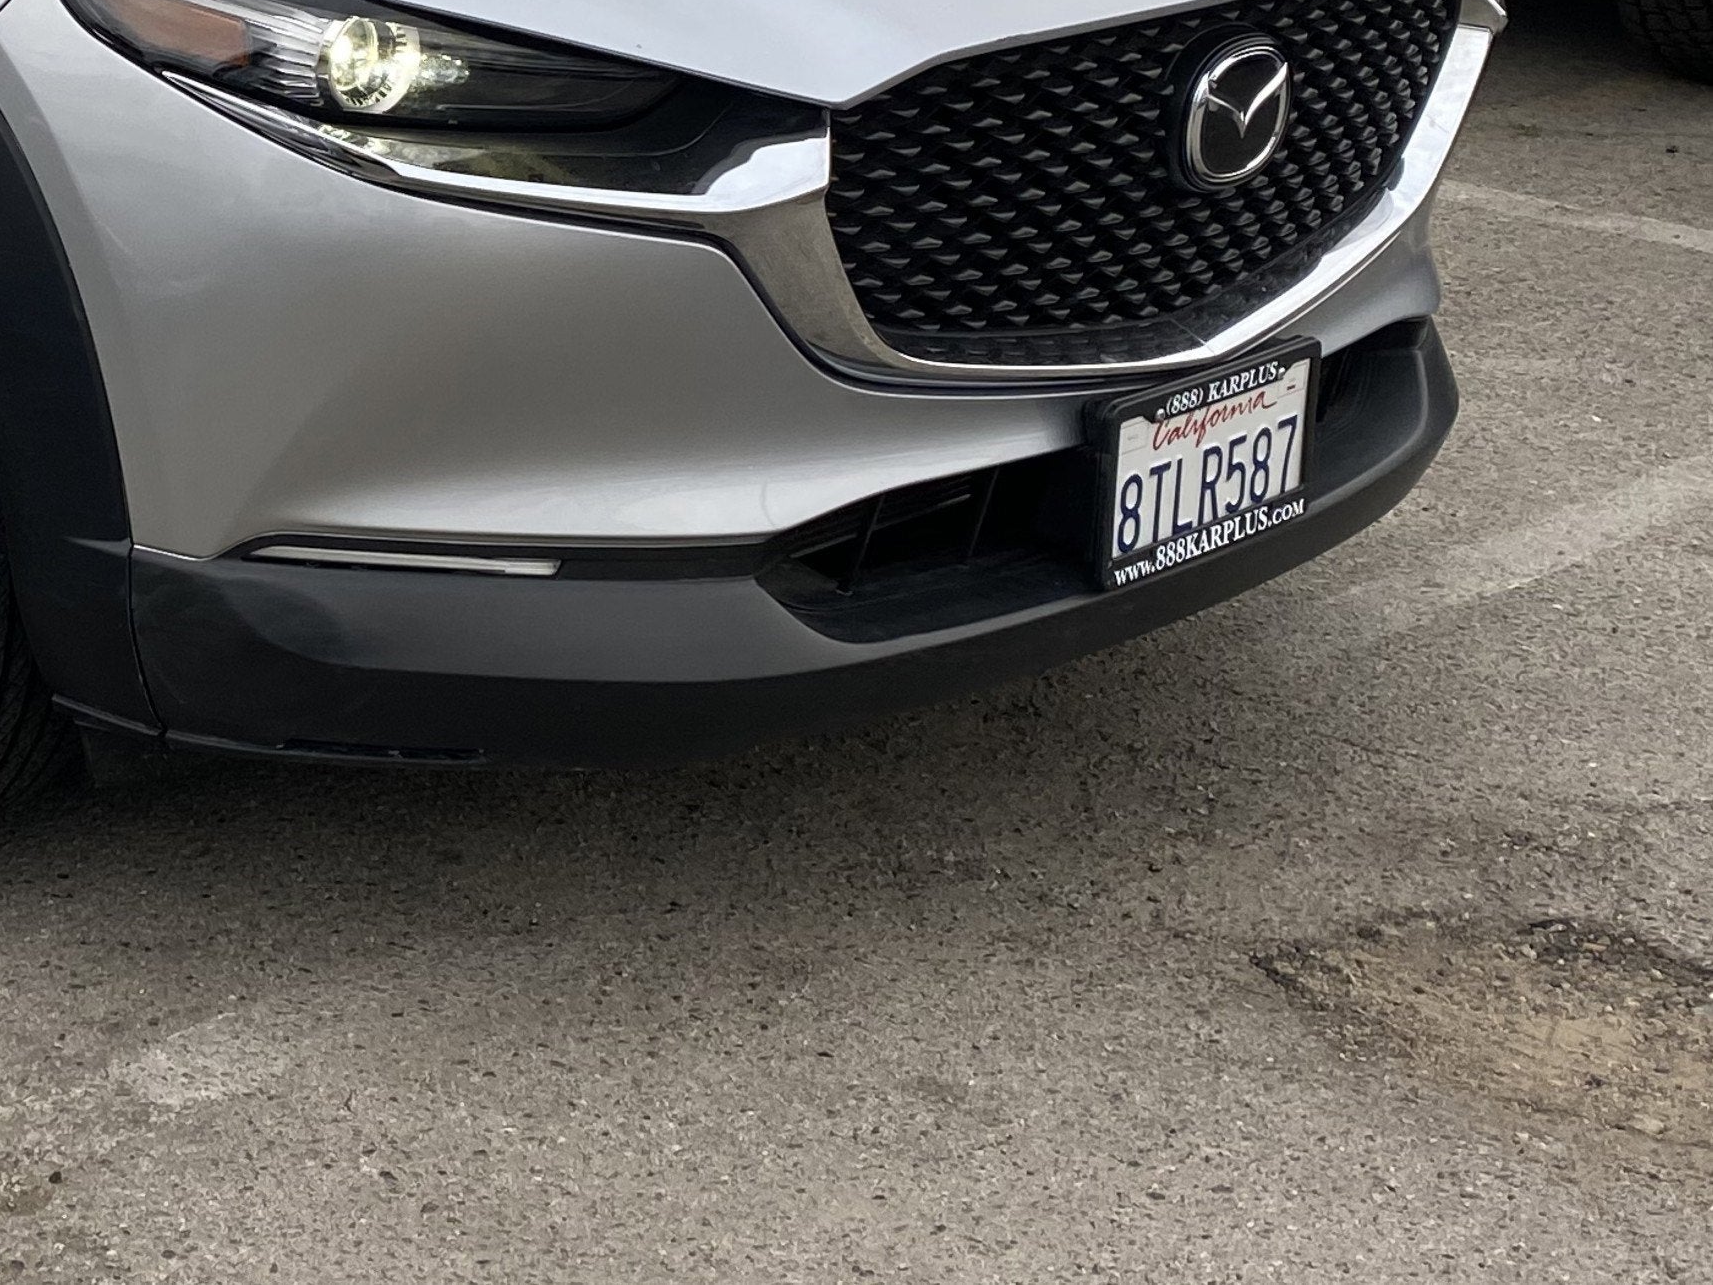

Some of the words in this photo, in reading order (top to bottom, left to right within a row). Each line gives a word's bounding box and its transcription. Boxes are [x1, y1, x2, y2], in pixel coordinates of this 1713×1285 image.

[1166, 389, 1204, 415] (888)
[1207, 361, 1279, 402] KARPLUS
[1152, 389, 1277, 451] California
[1117, 414, 1298, 553] 8TLR587
